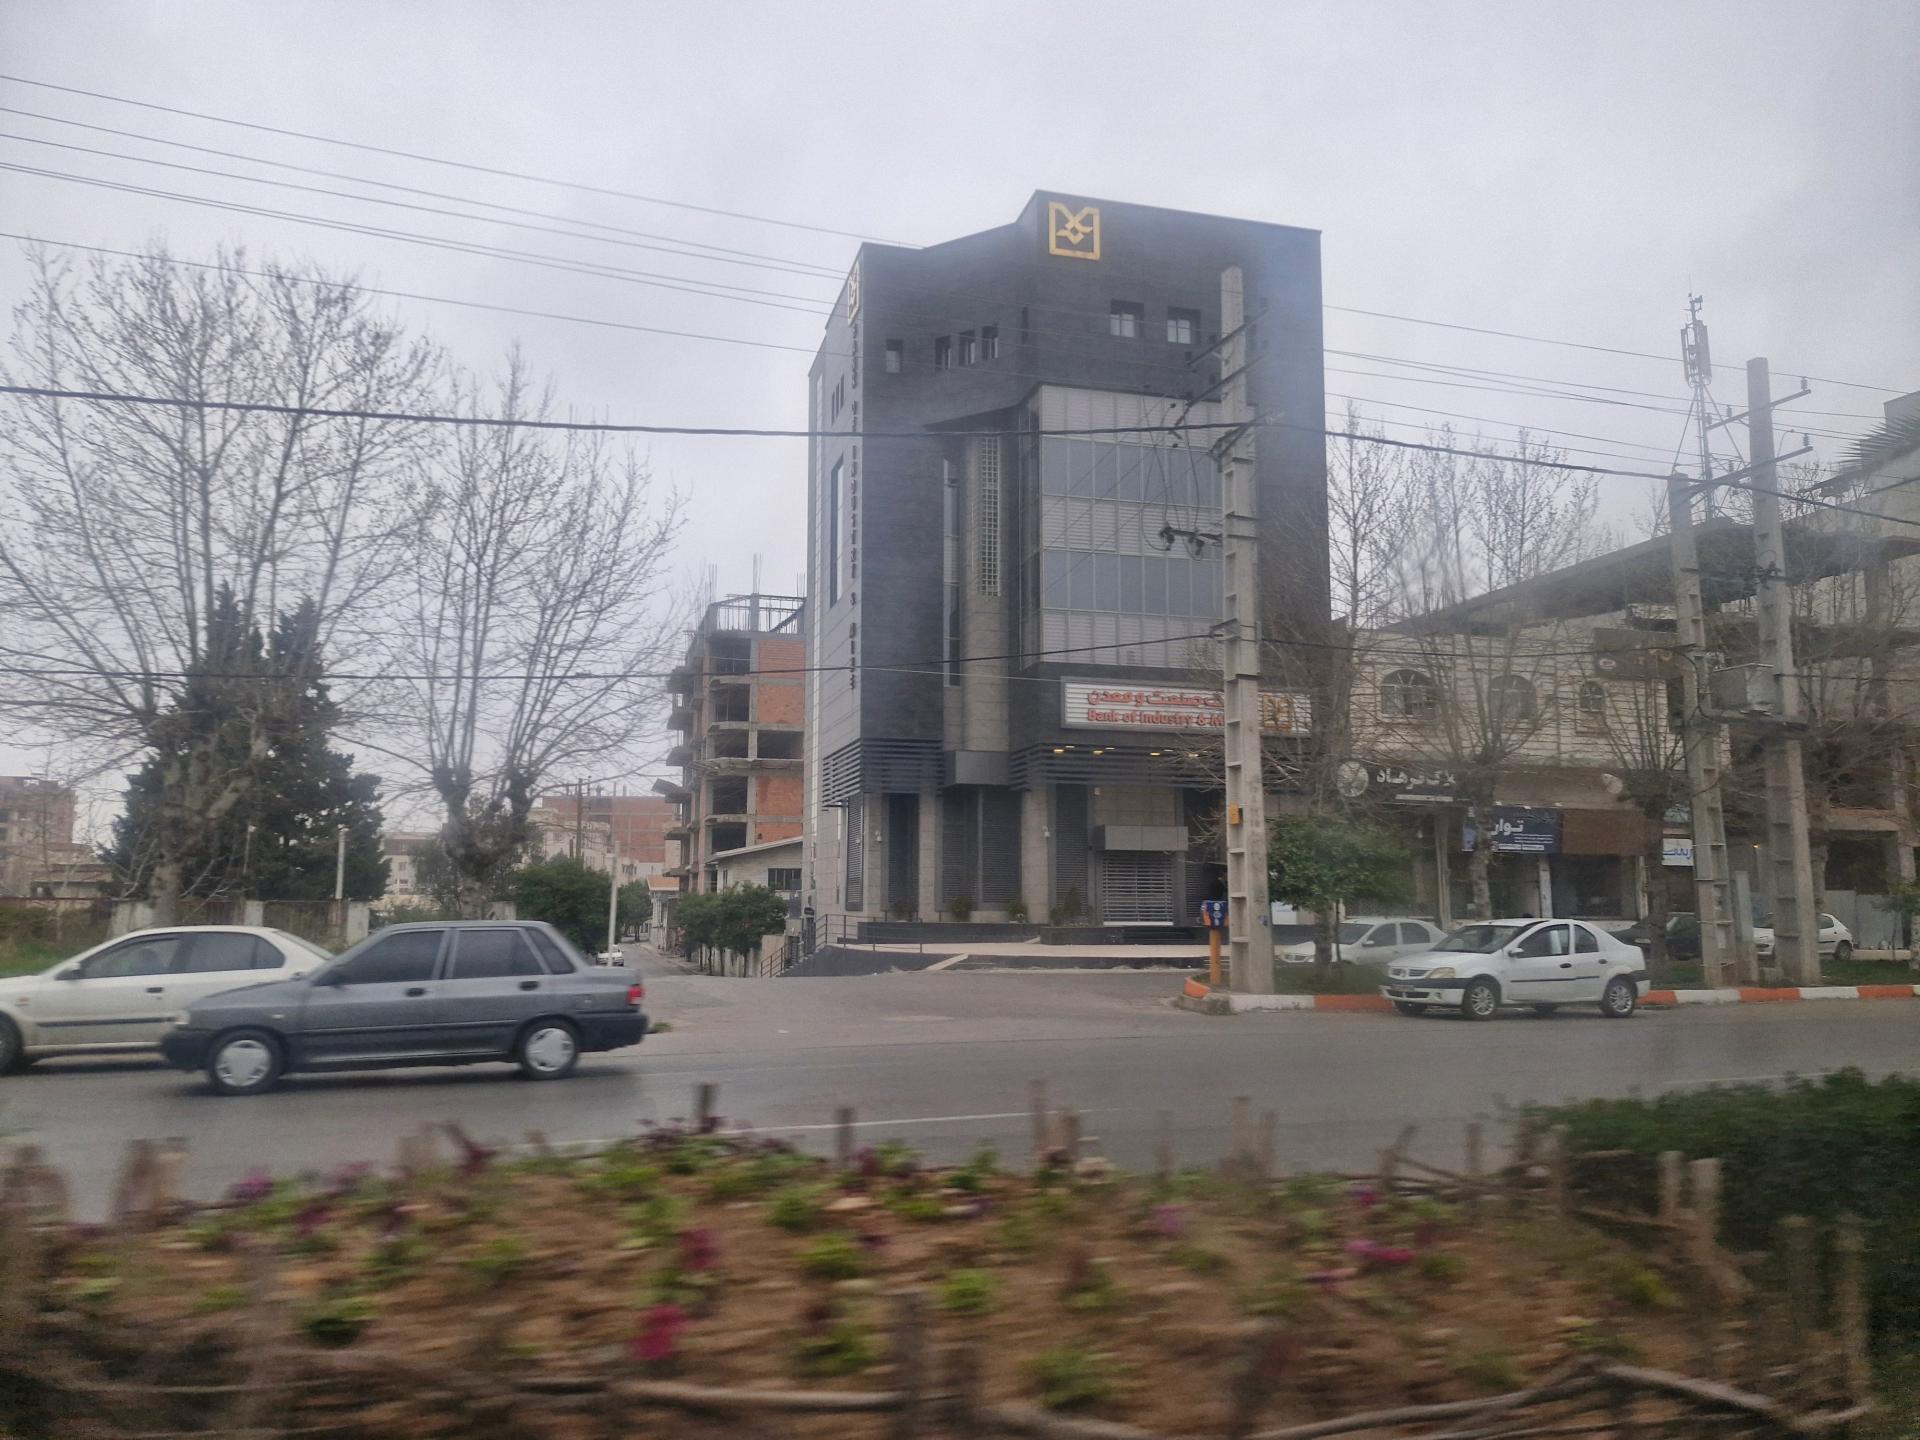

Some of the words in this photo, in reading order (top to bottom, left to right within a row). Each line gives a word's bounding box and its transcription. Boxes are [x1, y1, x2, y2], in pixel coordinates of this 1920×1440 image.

[1087, 690, 1133, 705] معدن
[1135, 692, 1145, 708] و
[1147, 691, 1204, 707] صنعت
[1087, 708, 1120, 722] Bank
[1123, 709, 1136, 723] of
[1140, 710, 1193, 727] Industry
[1197, 712, 1206, 726] &
